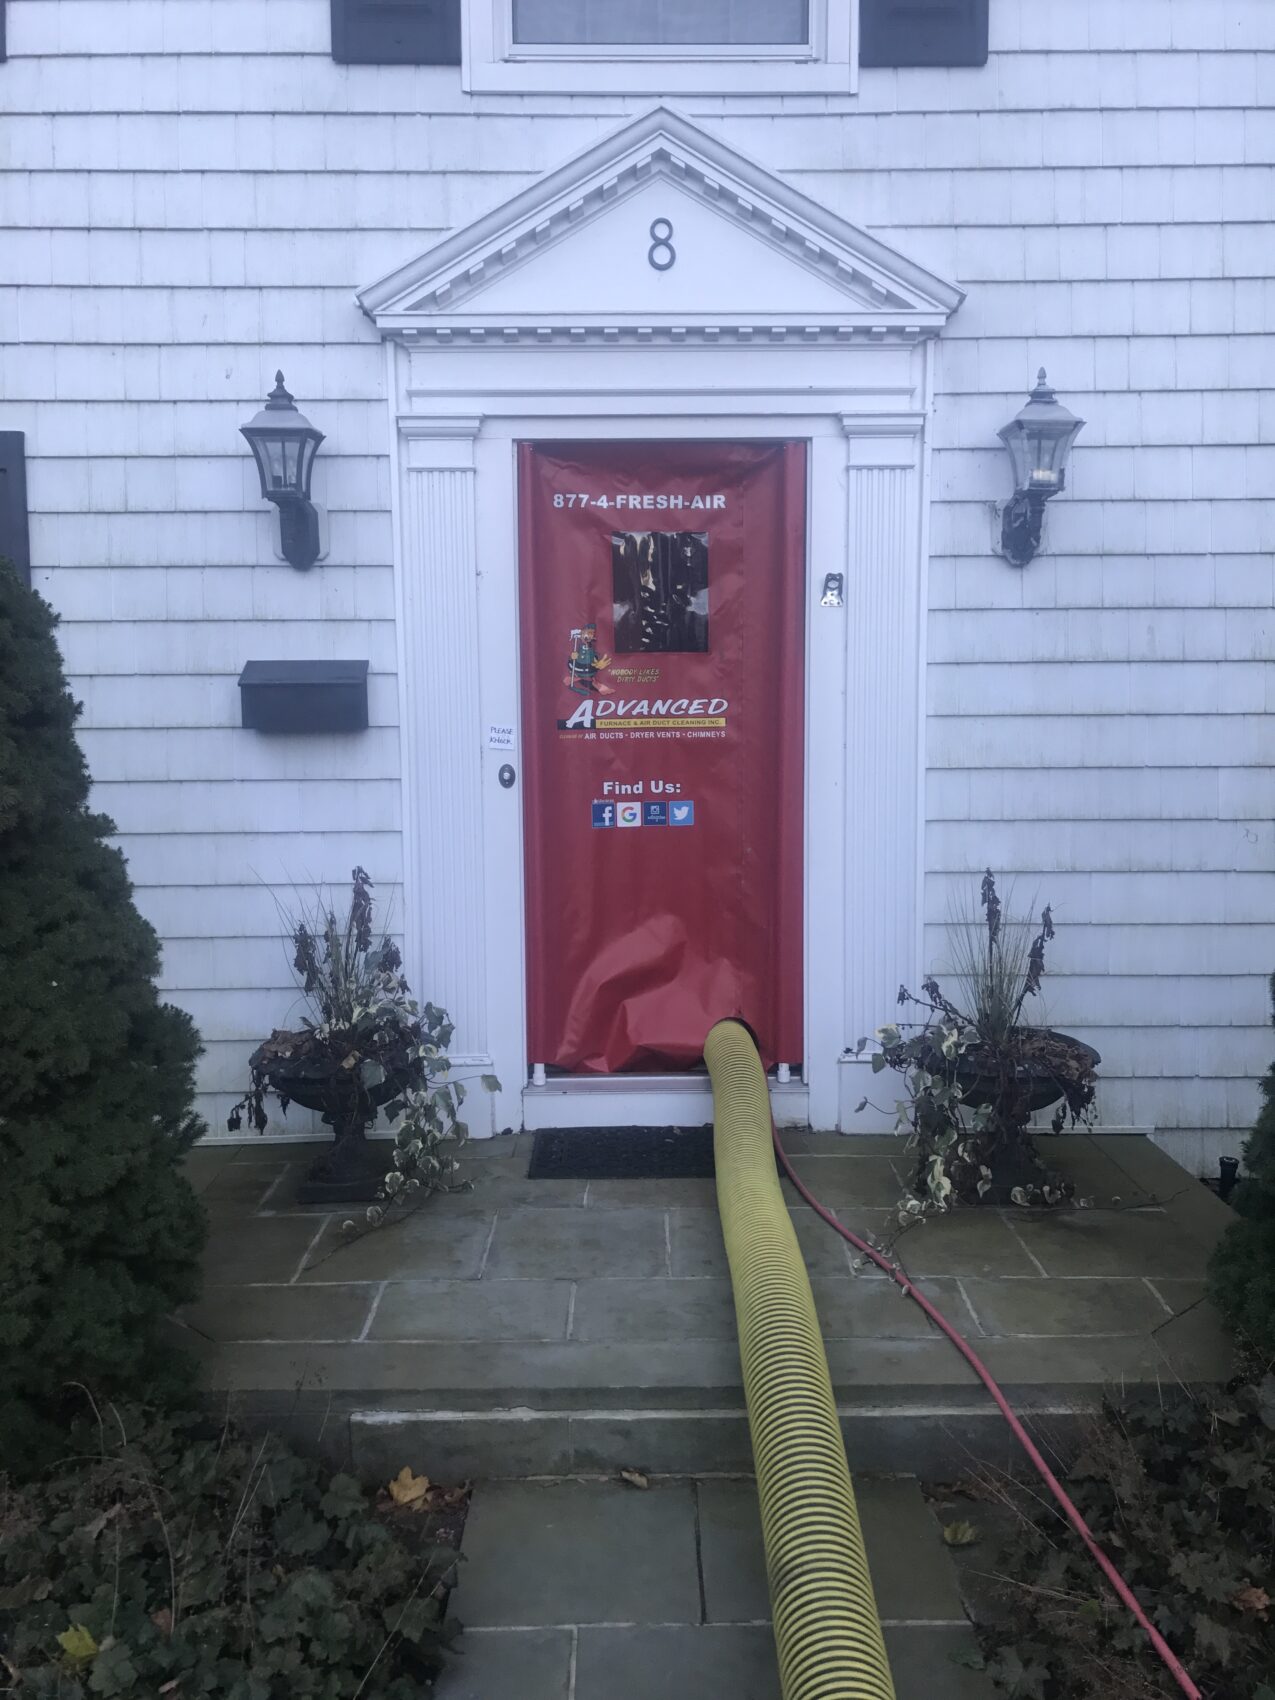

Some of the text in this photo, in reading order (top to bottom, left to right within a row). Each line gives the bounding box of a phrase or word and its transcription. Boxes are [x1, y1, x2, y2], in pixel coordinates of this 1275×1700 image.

[648, 217, 676, 271] 8
[553, 493, 726, 509] 877-4-FRESH-AIR
[566, 699, 728, 728] ADVANCED
[490, 726, 513, 735] PLEASE
[603, 780, 681, 795] Find Us:
